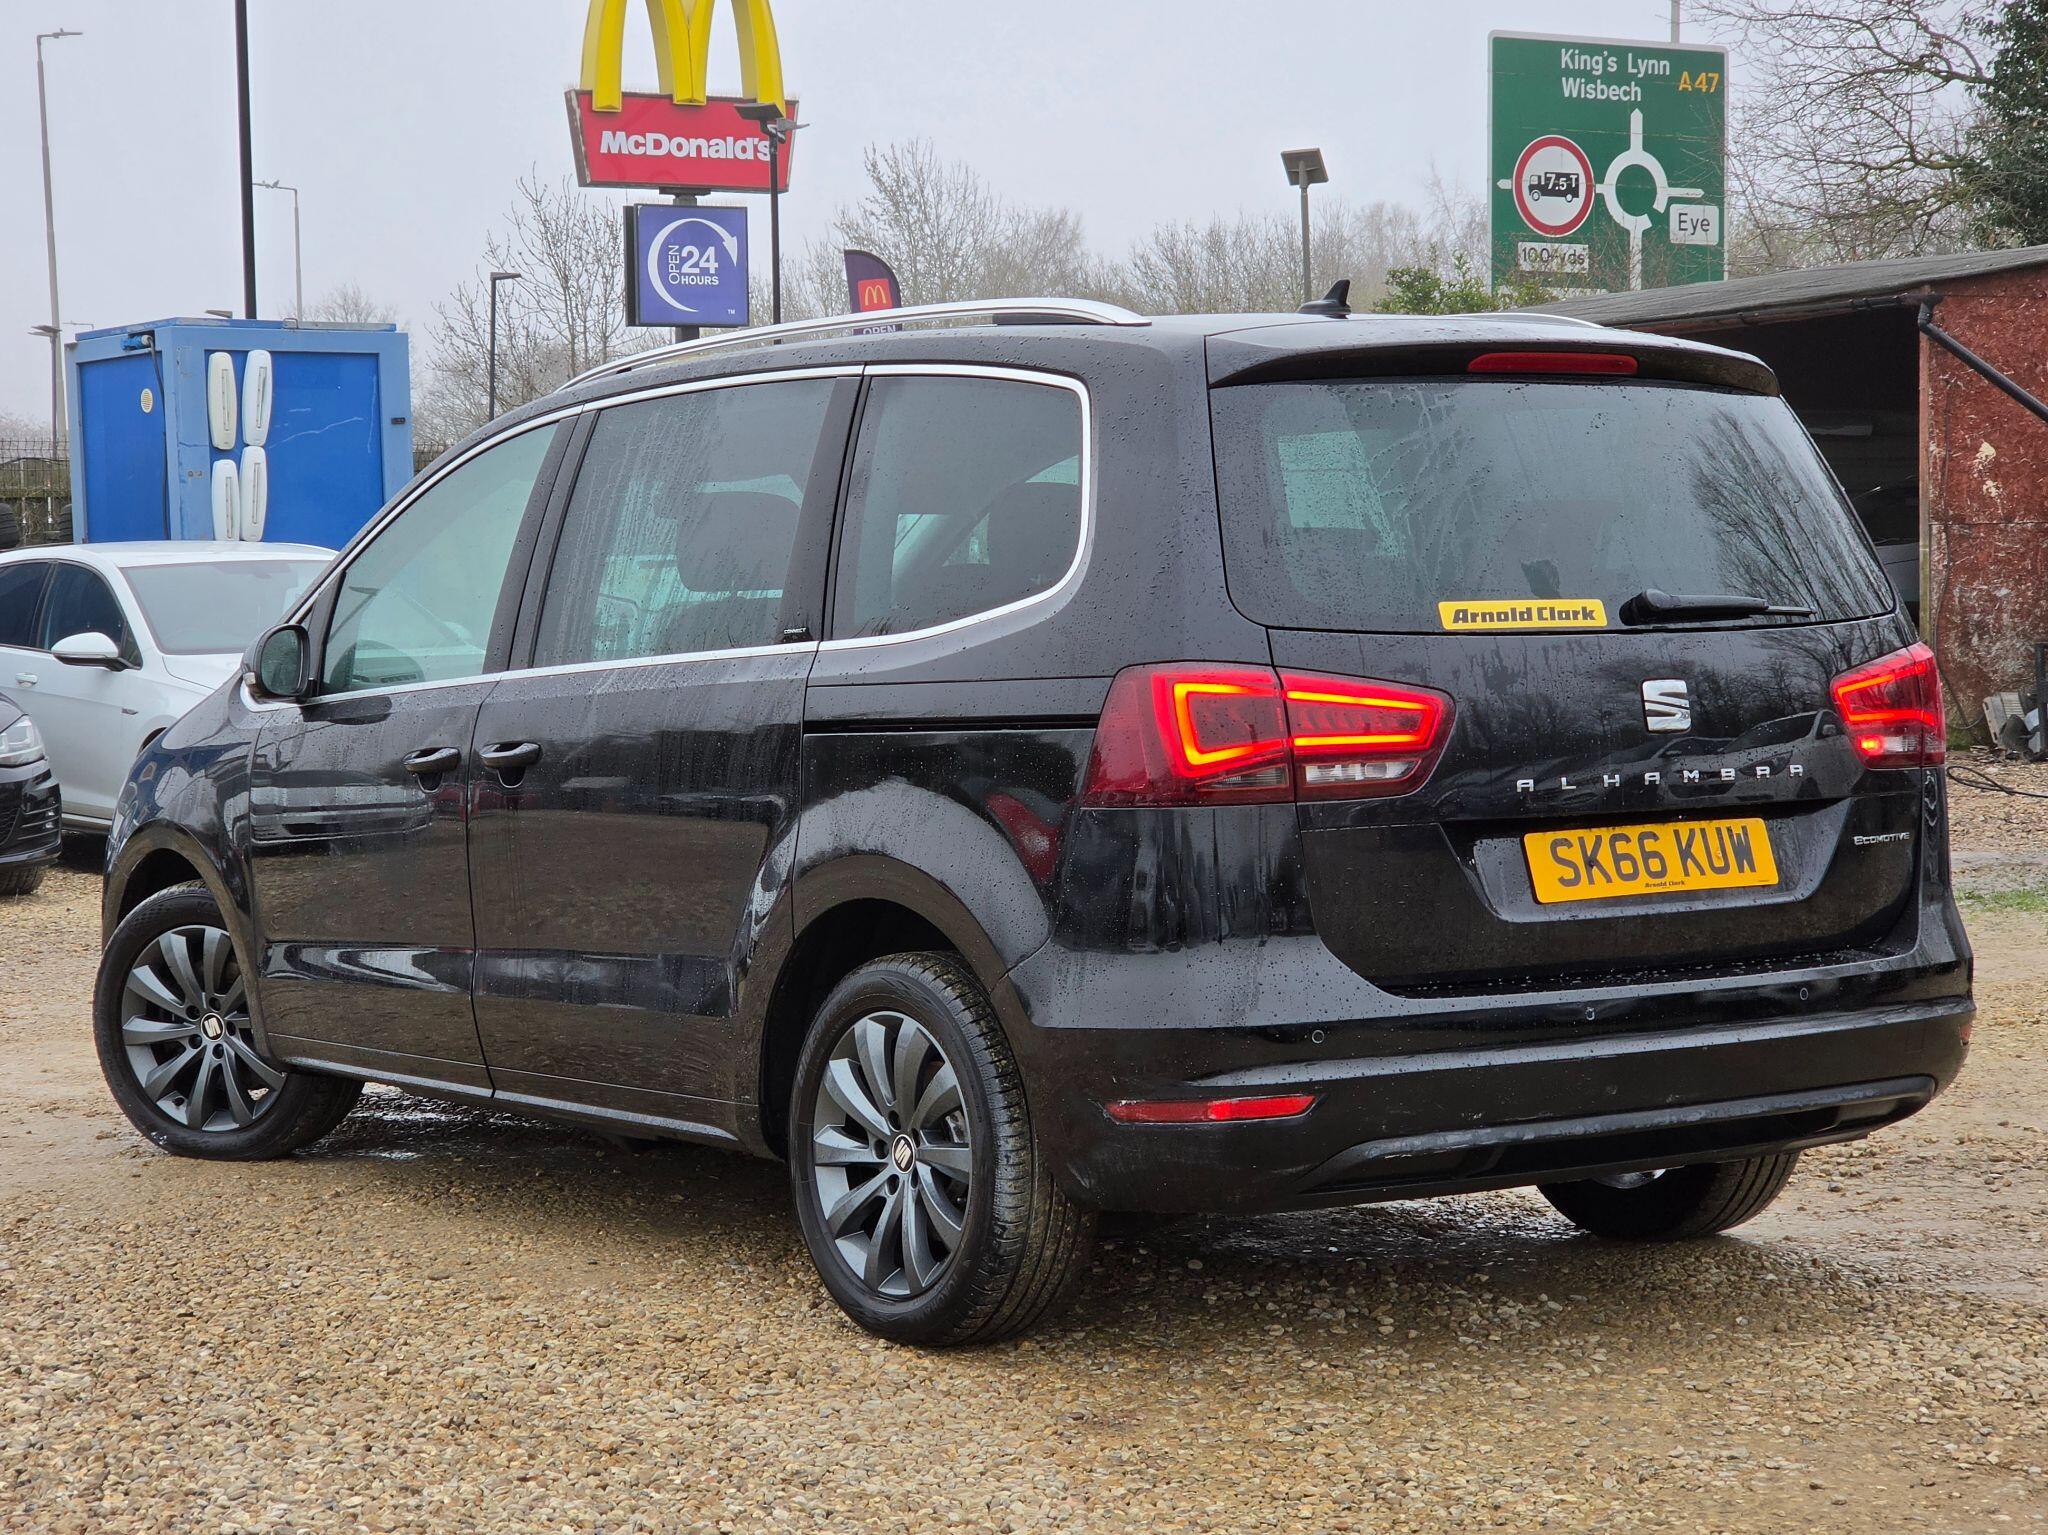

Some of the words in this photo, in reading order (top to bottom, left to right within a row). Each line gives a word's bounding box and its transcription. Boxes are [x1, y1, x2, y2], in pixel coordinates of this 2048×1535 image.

[1560, 48, 1618, 75] King's
[1627, 52, 1671, 78] Lynn
[1561, 77, 1642, 102] Wisbech
[1678, 70, 1720, 93] A47
[600, 130, 771, 161] McDonald's
[1678, 212, 1711, 236] Eye
[668, 245, 680, 285] OPEN
[681, 245, 719, 274] 24
[681, 275, 719, 285] HOURS
[1452, 606, 1533, 623] Arnold
[1537, 606, 1596, 622] Clark
[1516, 763, 1804, 793] ALHAMBRA
[1550, 830, 1668, 888] SK66
[1673, 824, 1757, 878] KUW
